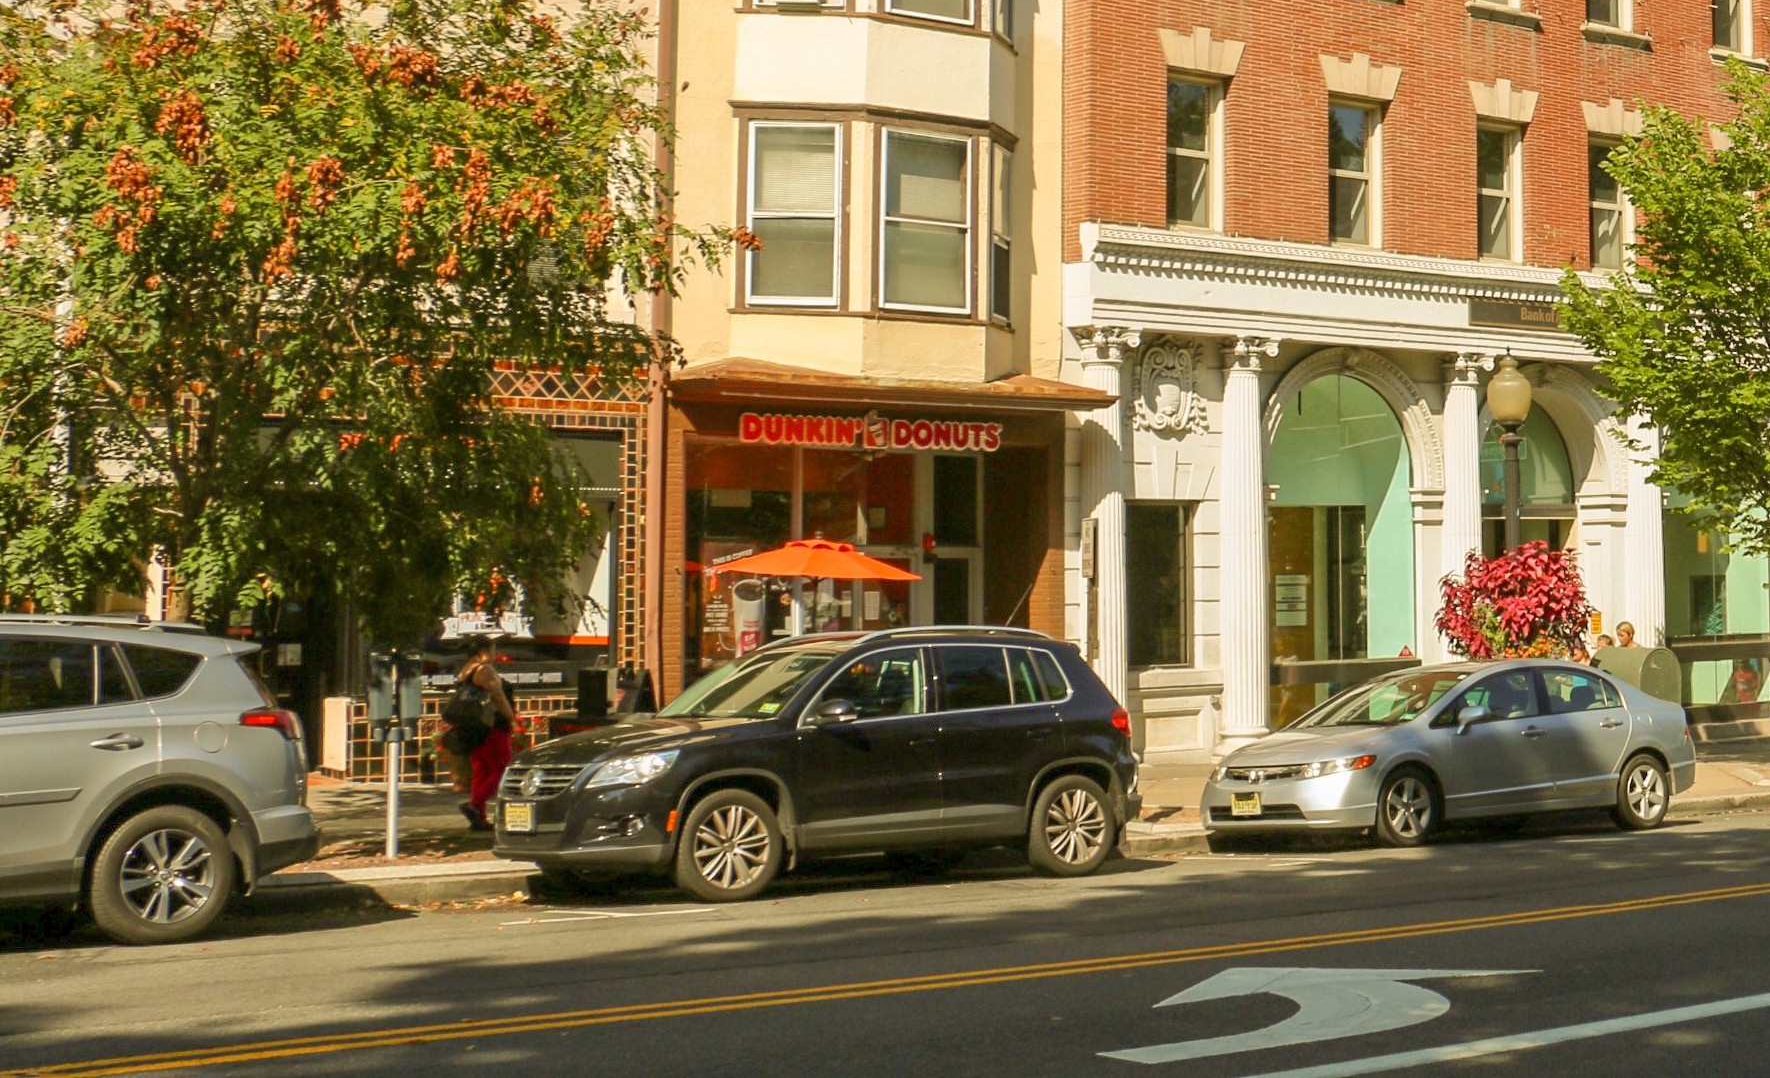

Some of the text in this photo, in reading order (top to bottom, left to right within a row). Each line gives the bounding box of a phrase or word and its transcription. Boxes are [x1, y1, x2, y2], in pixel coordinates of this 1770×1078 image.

[1520, 307, 1545, 322] Bank
[740, 412, 1001, 452] DUNKIN' DONUTS
